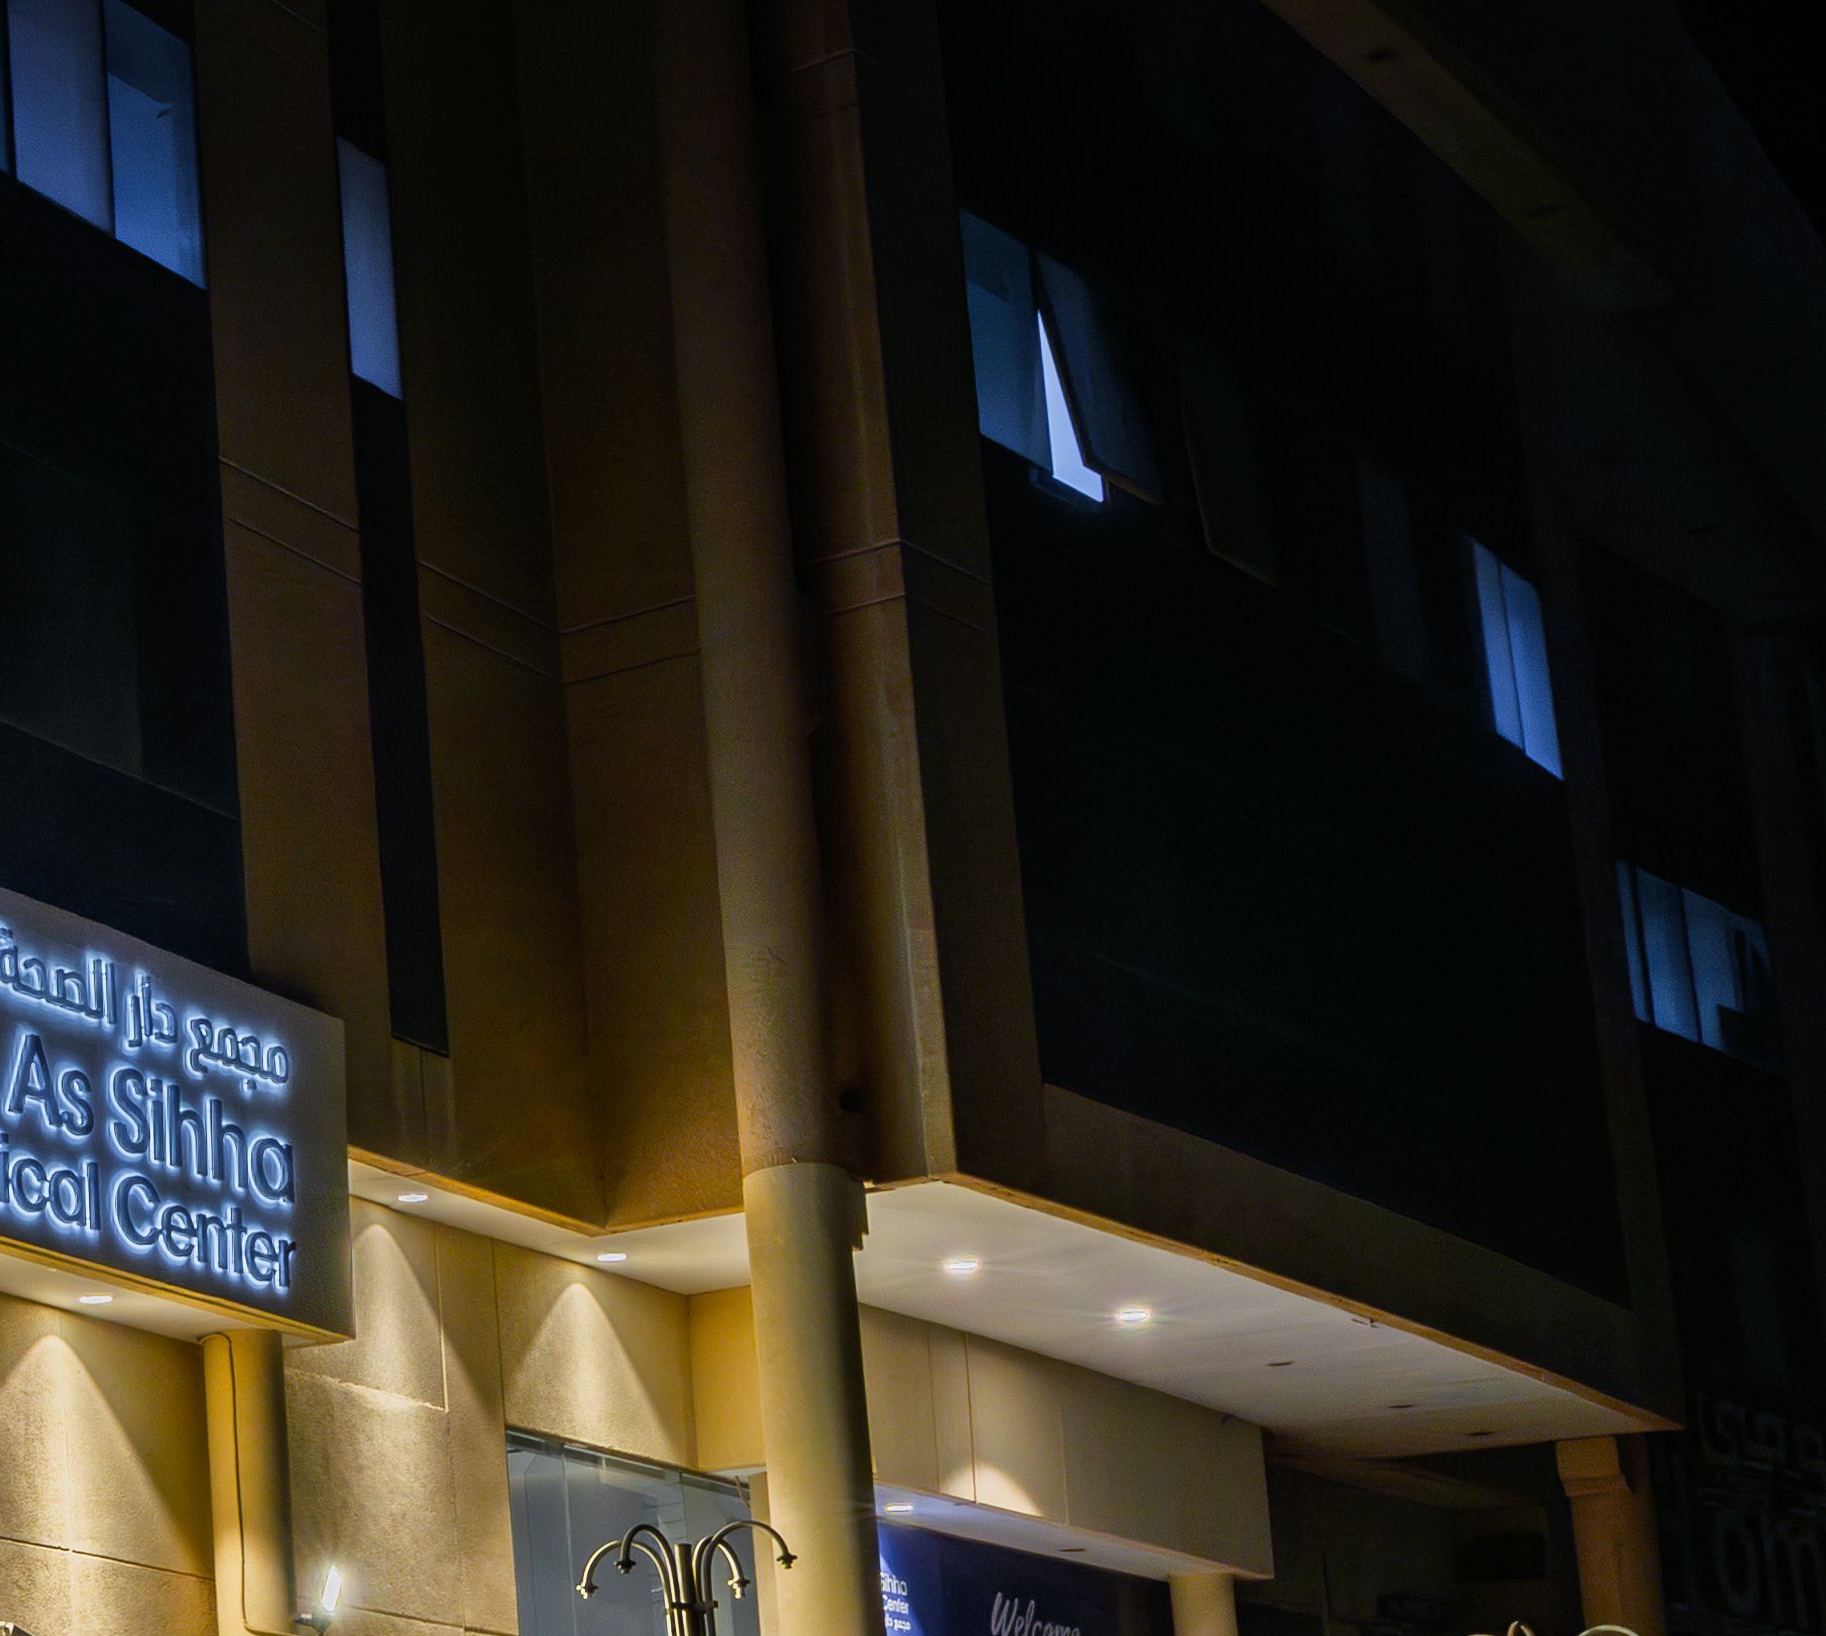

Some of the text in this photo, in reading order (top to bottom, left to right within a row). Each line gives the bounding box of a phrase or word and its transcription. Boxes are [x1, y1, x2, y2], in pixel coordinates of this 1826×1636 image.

[128, 975, 177, 1047] دار
[190, 1018, 290, 1090] مجمع
[7, 1034, 94, 1136] As
[112, 1067, 295, 1203] Sihha
[115, 1175, 296, 1288] Center
